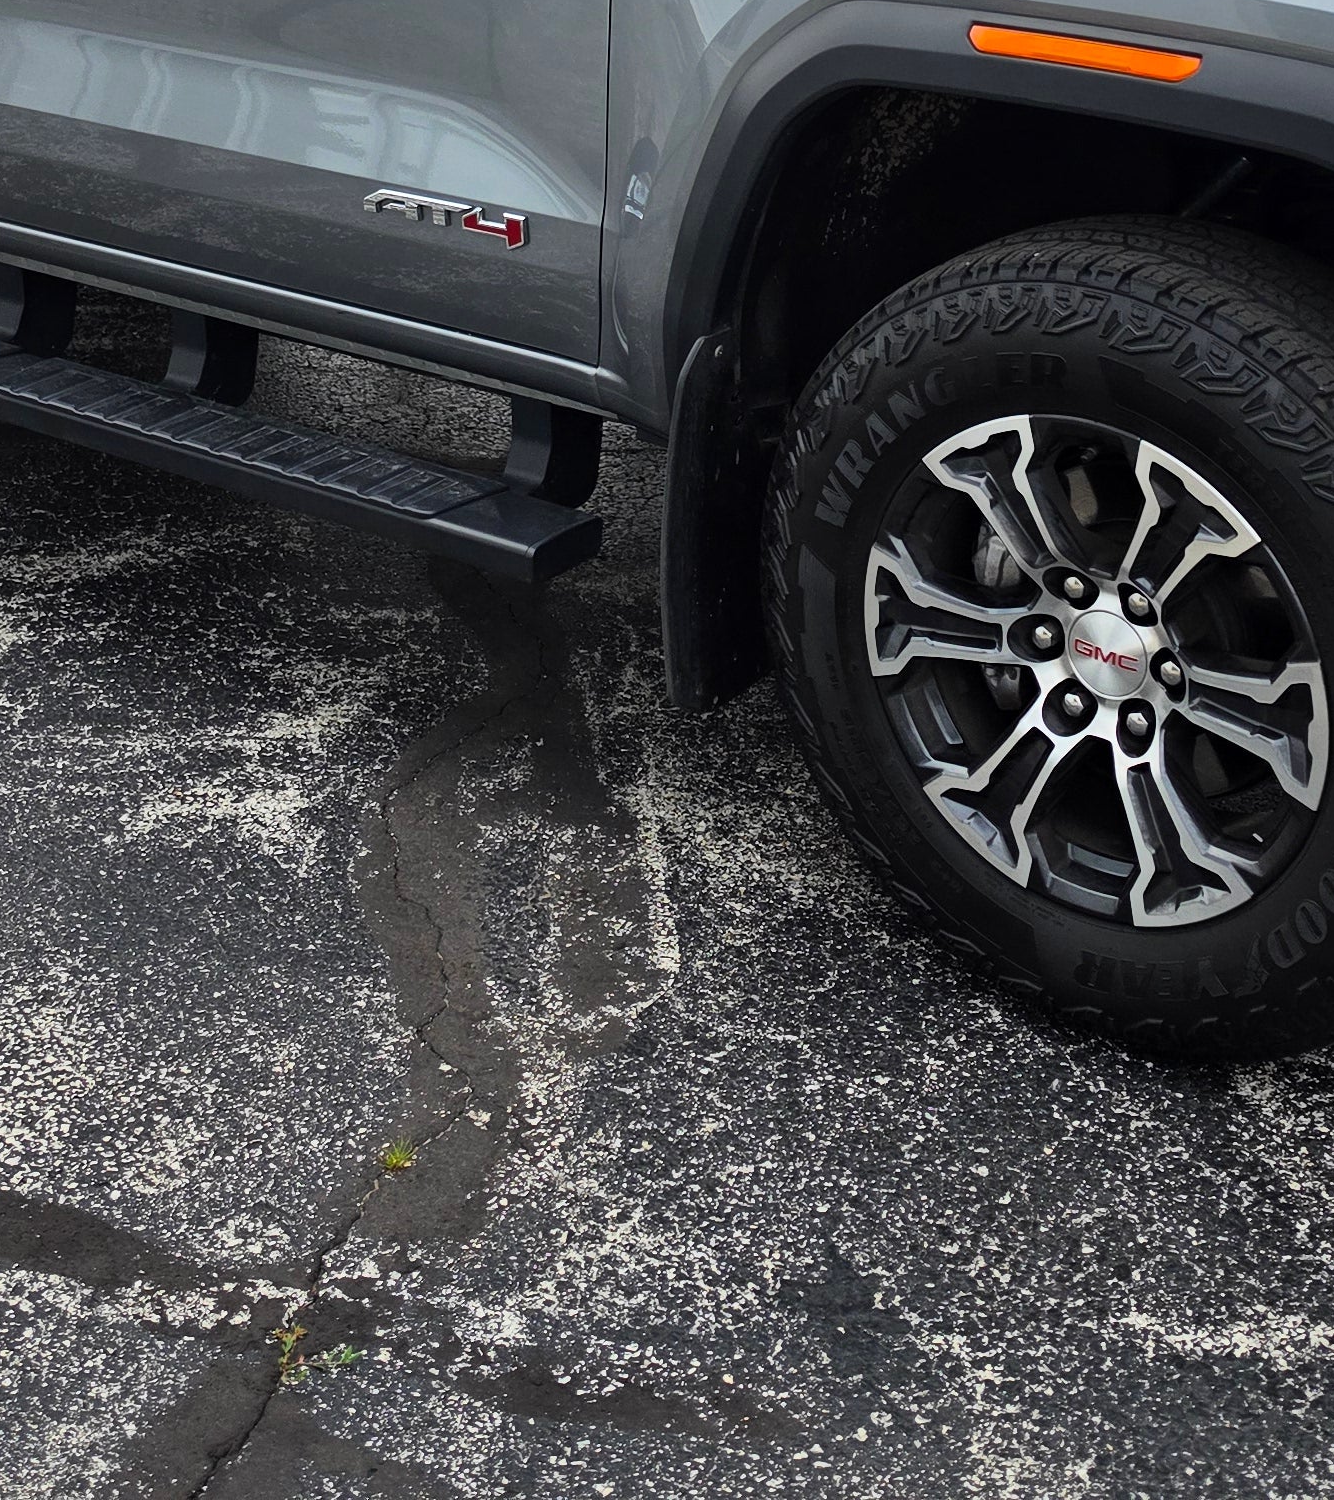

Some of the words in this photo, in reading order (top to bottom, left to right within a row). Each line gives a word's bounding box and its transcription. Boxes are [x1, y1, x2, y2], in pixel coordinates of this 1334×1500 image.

[363, 188, 530, 251] AT4
[814, 351, 1069, 530] WRANGLER
[1074, 637, 1139, 673] GMC
